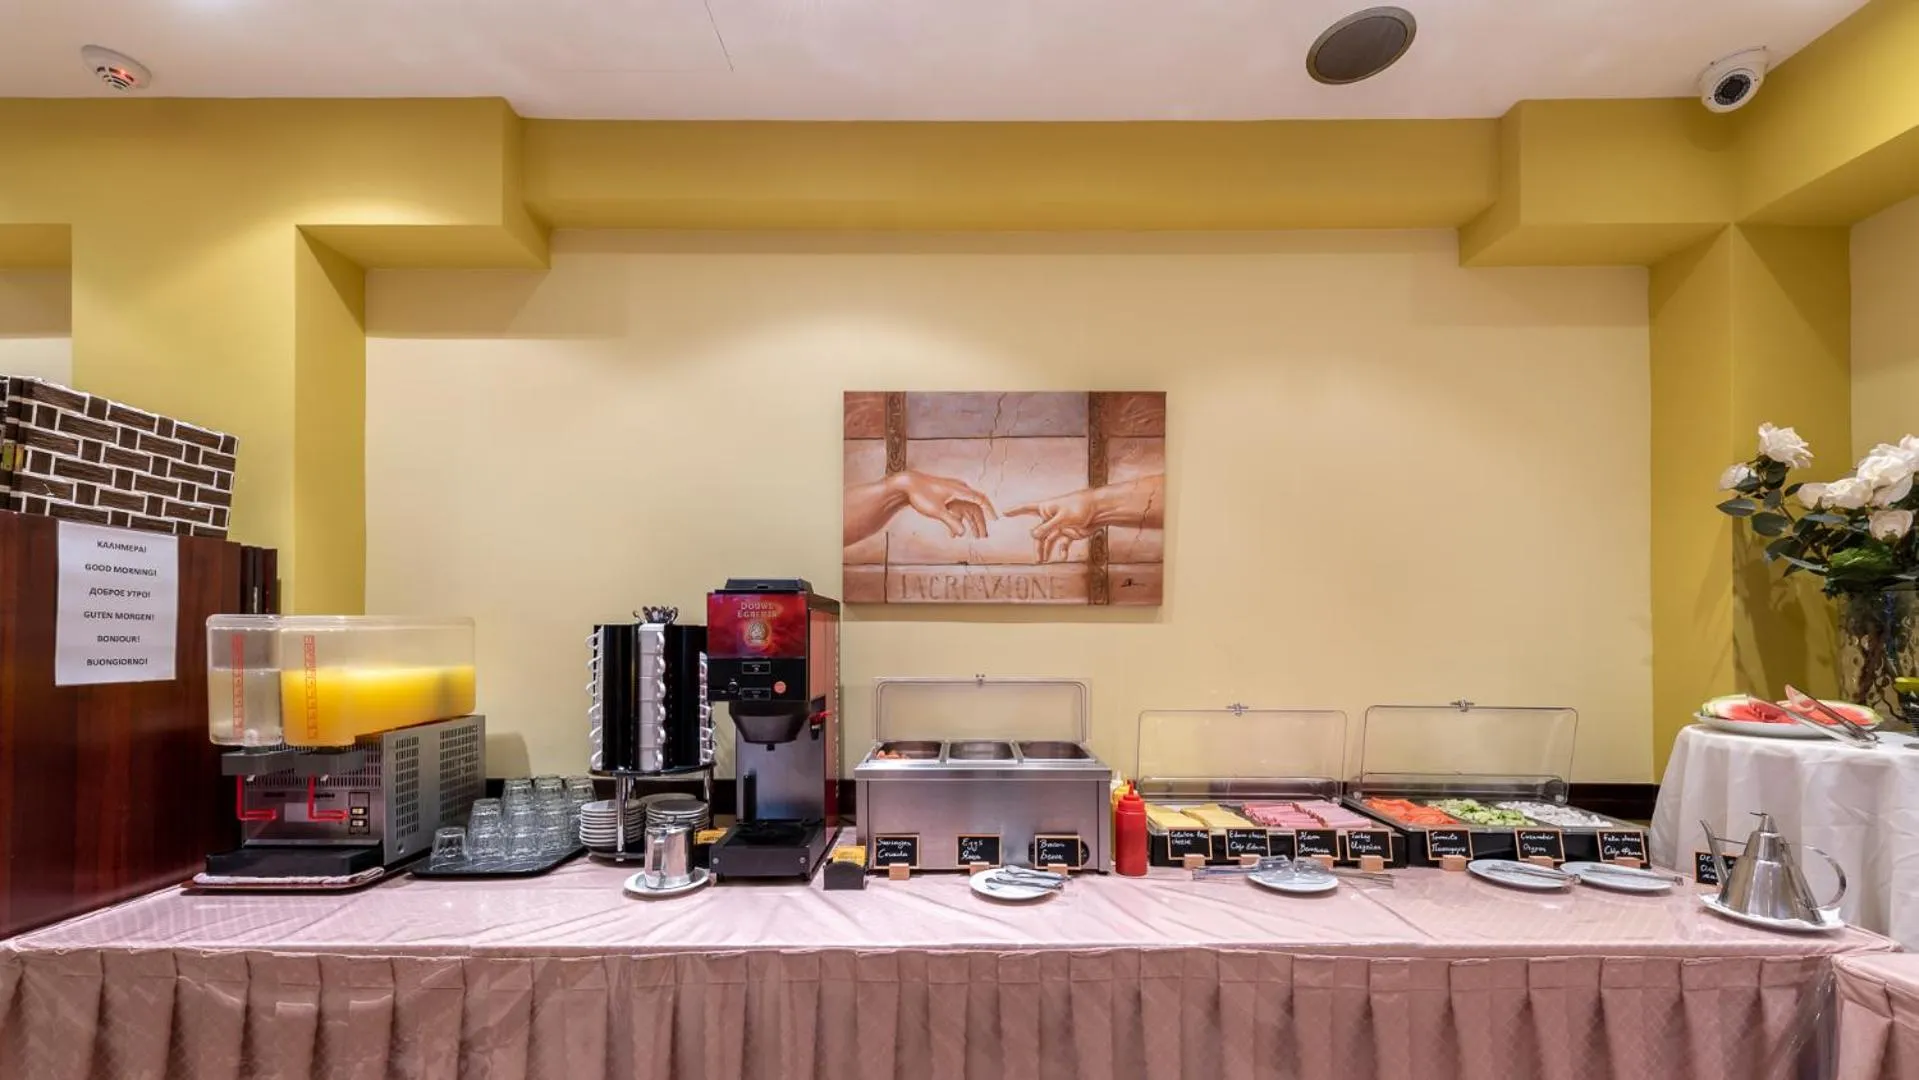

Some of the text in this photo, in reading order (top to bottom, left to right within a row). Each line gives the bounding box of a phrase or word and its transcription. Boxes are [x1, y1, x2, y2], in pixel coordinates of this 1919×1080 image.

[85, 564, 156, 576] GOOD MORNING!
[88, 587, 151, 598] ДОБРОЕ УТРО!
[741, 602, 773, 610] DOUWE
[83, 611, 155, 621] GUTEN MORGEN!
[97, 635, 140, 643] BONJOUR!
[86, 658, 148, 666] BUONGIORNO!
